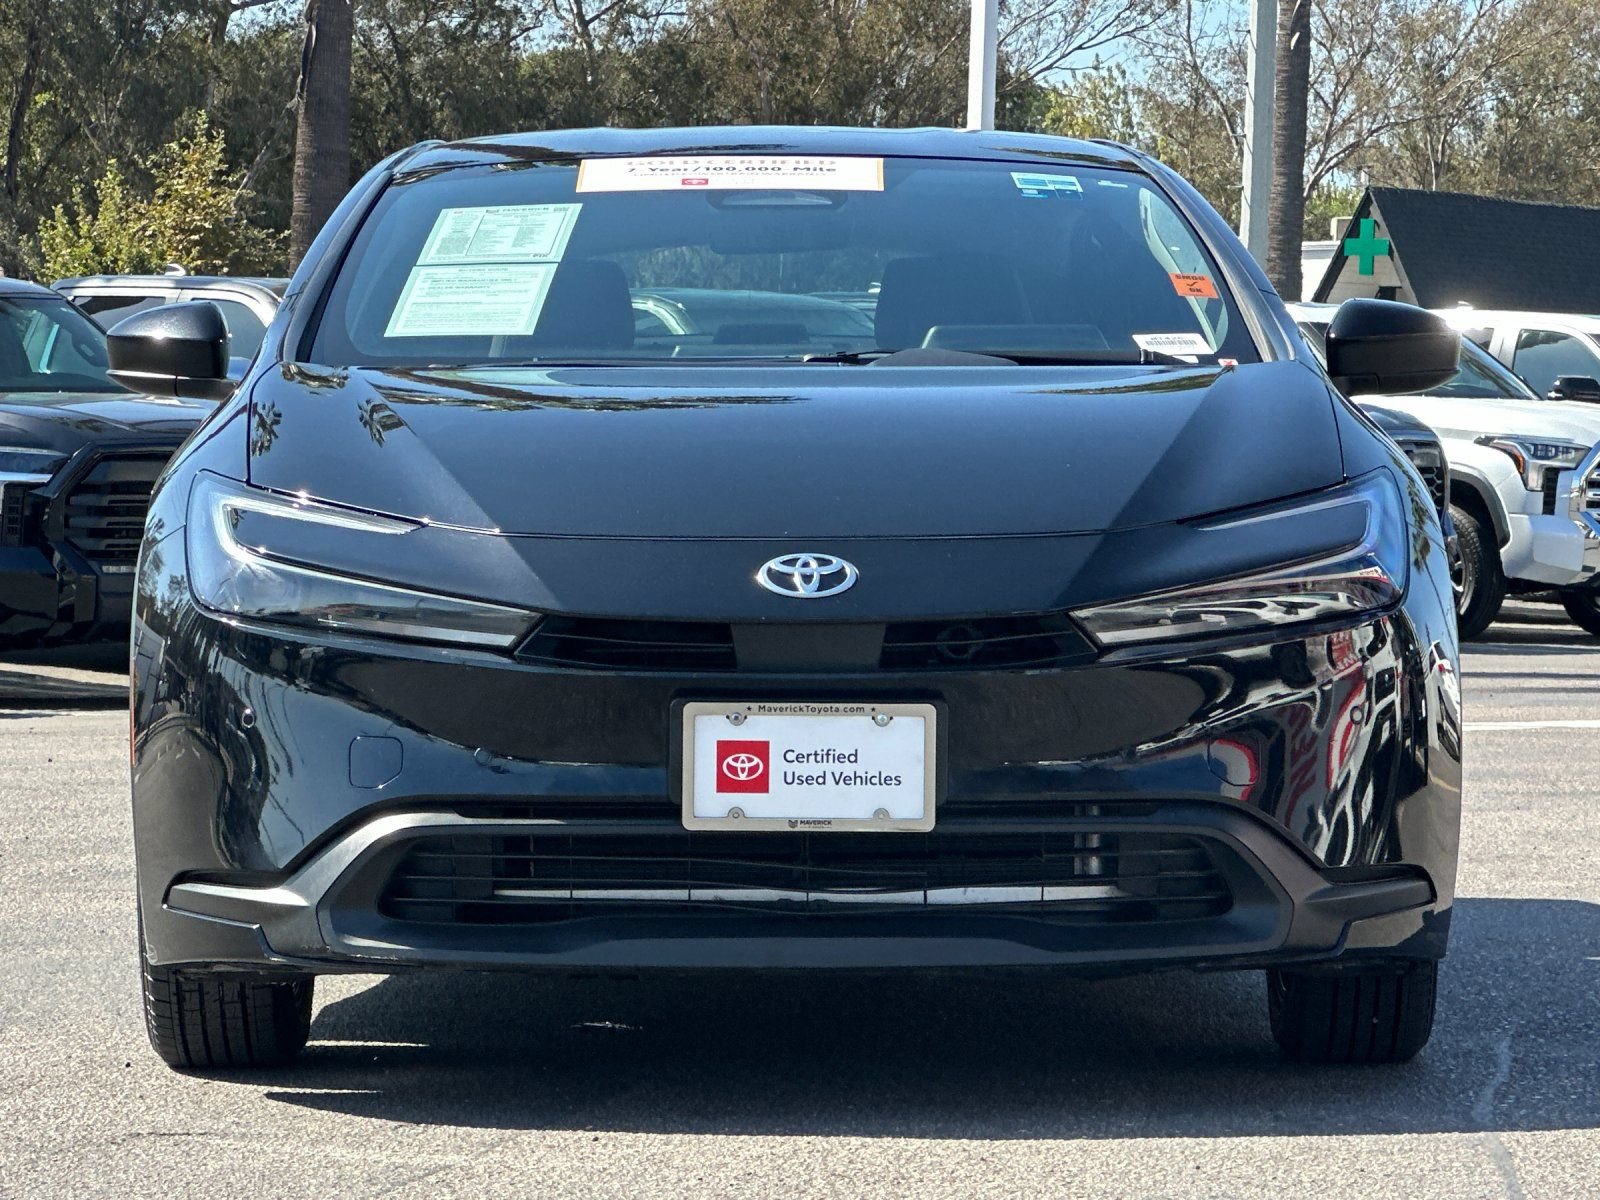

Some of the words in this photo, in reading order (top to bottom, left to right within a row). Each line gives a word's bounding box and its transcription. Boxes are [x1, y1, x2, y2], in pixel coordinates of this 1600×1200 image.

[758, 705, 865, 714] MaverickToyota.com
[783, 749, 858, 764] Certified
[783, 771, 826, 786] Used
[831, 771, 902, 786] Vehicles
